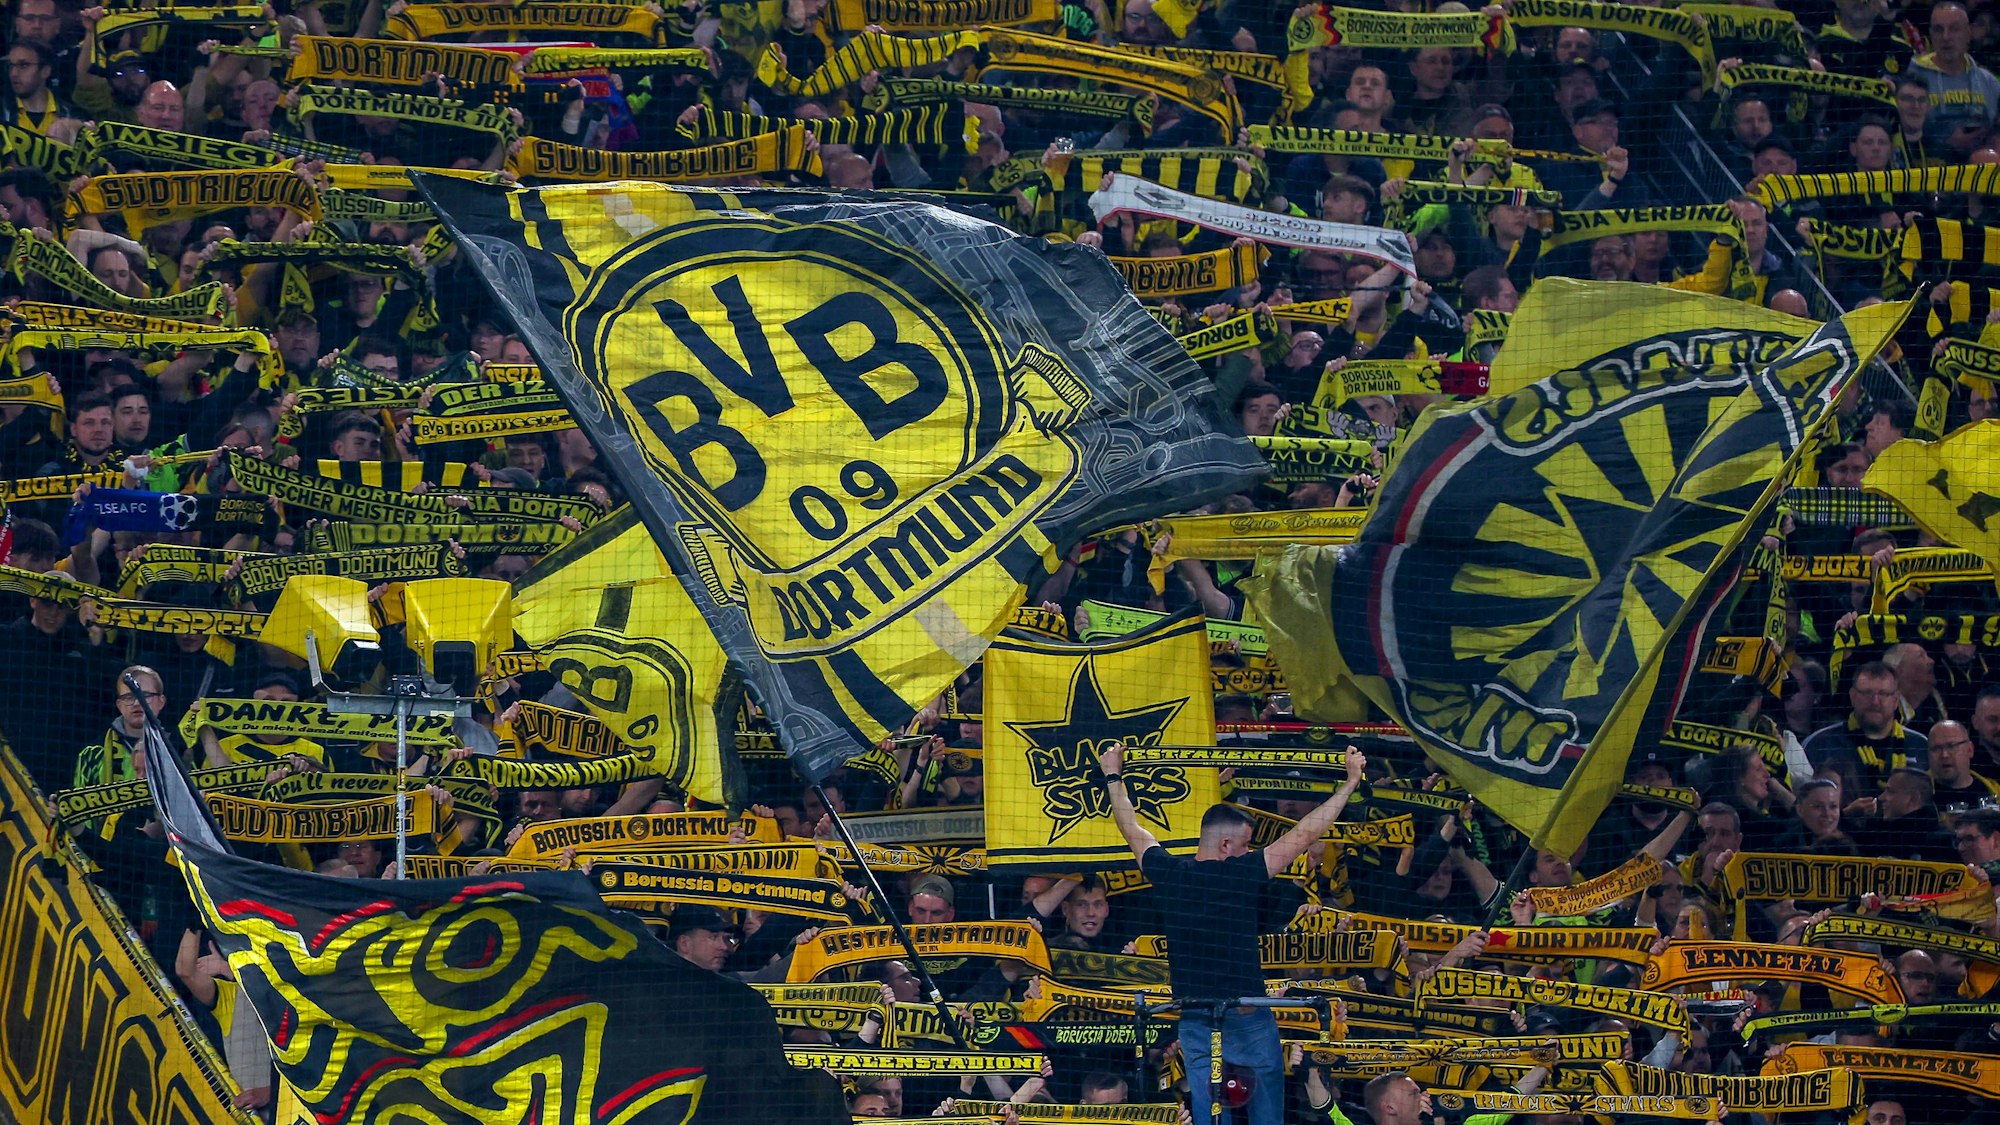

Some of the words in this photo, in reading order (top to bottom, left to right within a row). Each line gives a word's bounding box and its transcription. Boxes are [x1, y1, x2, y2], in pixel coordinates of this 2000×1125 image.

[1507, 1, 1594, 20] RUSSIA
[1346, 18, 1406, 35] BORUSSIA
[1411, 18, 1478, 35] DORTMUND
[316, 40, 514, 84] DORTMUND
[312, 95, 467, 123] DORTMUNDER
[890, 81, 1003, 98] BORUSSIA
[1011, 87, 1128, 111] DORTMUND
[1270, 127, 1336, 143] NUR
[1345, 131, 1408, 146] DER
[1416, 135, 1452, 149] BV
[533, 137, 758, 177] SÜDTRIBÜNE
[24, 304, 94, 326] SSIA
[1340, 369, 1394, 384] BORUSSIA
[440, 384, 503, 407] DER
[622, 274, 948, 512] BVB
[421, 418, 448, 437] BVB
[230, 451, 337, 493] BORUSSIA
[131, 502, 147, 513] FC
[233, 468, 333, 512] DEUTSCHER
[339, 499, 417, 524] MEISTER
[788, 459, 899, 541] 09
[145, 548, 201, 562] VEREIN.
[771, 453, 1044, 642] DORTMUND
[242, 560, 327, 588] BORUSSIA
[338, 552, 438, 577] DORTMUND
[1232, 670, 1263, 685] BVB
[206, 701, 350, 729] DANKE,
[263, 724, 295, 733] mich
[298, 727, 345, 736] damals
[1033, 734, 1161, 785] BLA
[1124, 750, 1346, 766] ESTFALENSTADI
[192, 763, 293, 790] ORTMUN
[331, 776, 388, 791] never
[479, 758, 577, 788] BORUSSIA
[1235, 780, 1311, 790] SUPPORTERS
[531, 819, 626, 854] BORUSSIA
[652, 816, 757, 837] DORTMUD
[623, 871, 714, 893] Borussia
[717, 877, 826, 904] Dortmund
[1744, 858, 1965, 899] SÜDTRIBÜNE
[820, 926, 1032, 955] WESTFALENSTADION
[1517, 930, 1657, 951] DORTMUND
[1682, 949, 1846, 979] LENNETAL
[1055, 1030, 1104, 1044] BORUSSIA
[1104, 1030, 1158, 1044] DORTMND
[1822, 1051, 1981, 1081] LENNETAL
[1071, 1104, 1180, 1125] DORTMUND
[1474, 1093, 1559, 1112] BLACK
[1595, 1095, 1675, 1113] STARS
